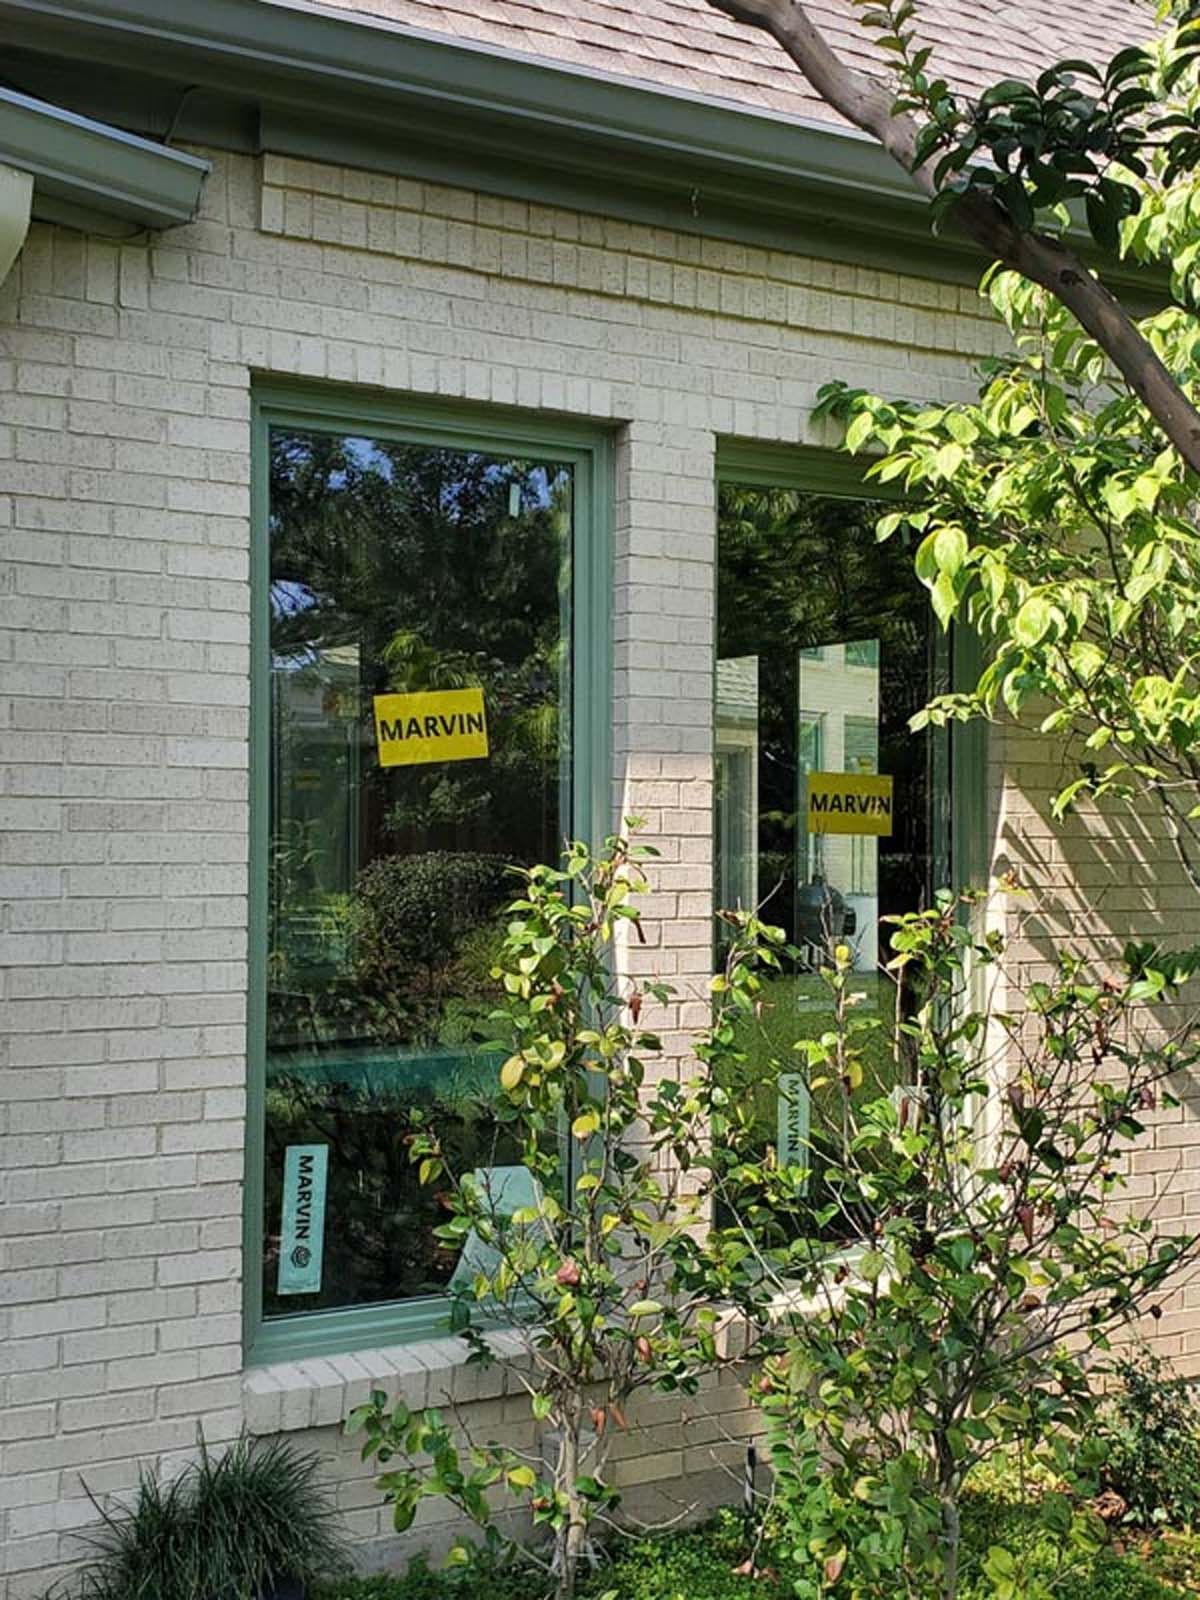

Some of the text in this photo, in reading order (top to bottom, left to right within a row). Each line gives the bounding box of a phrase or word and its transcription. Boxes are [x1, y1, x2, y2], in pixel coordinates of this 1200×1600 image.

[380, 712, 484, 741] MARVIN
[811, 793, 891, 814] MARVIN
[295, 1155, 314, 1240] MARVIN
